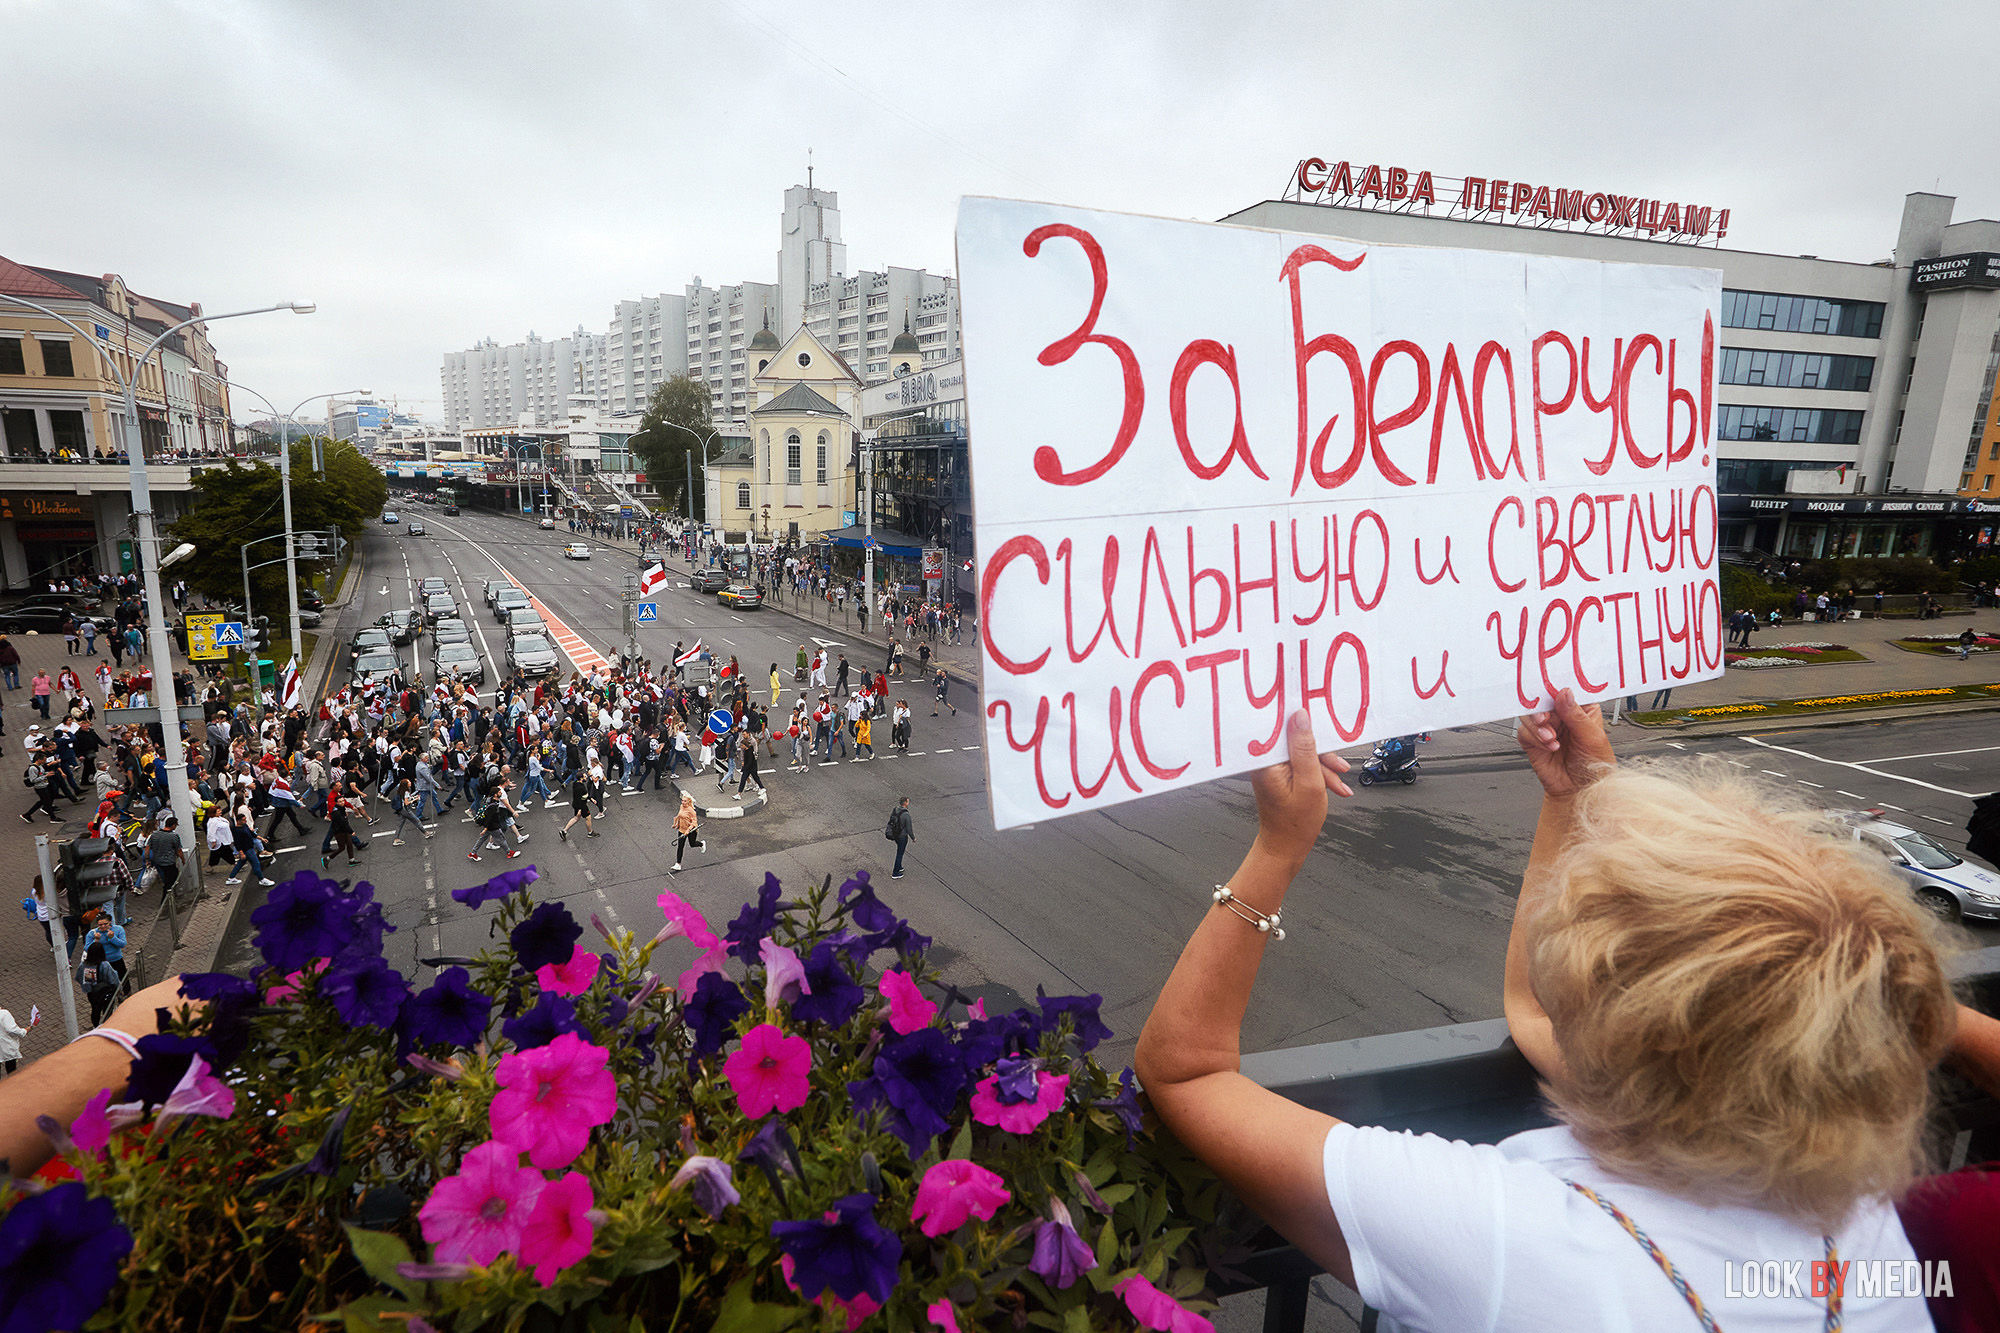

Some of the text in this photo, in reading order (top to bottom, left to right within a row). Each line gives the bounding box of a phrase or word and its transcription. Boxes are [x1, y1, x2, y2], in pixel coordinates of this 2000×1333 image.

[1298, 157, 1731, 238] СЛАВА ПЕРАМОЖЦАМ!
[1917, 258, 1970, 274] FASHION
[1917, 269, 1967, 283] CENTRE
[1023, 223, 1714, 497] За Беларусь!
[23, 498, 81, 514] Woodman
[1750, 500, 1845, 512] ЦЕНТР МОДЫ
[1881, 502, 1945, 511] FASHION CENTRE
[1415, 535, 1461, 586] и
[1411, 649, 1457, 700] и
